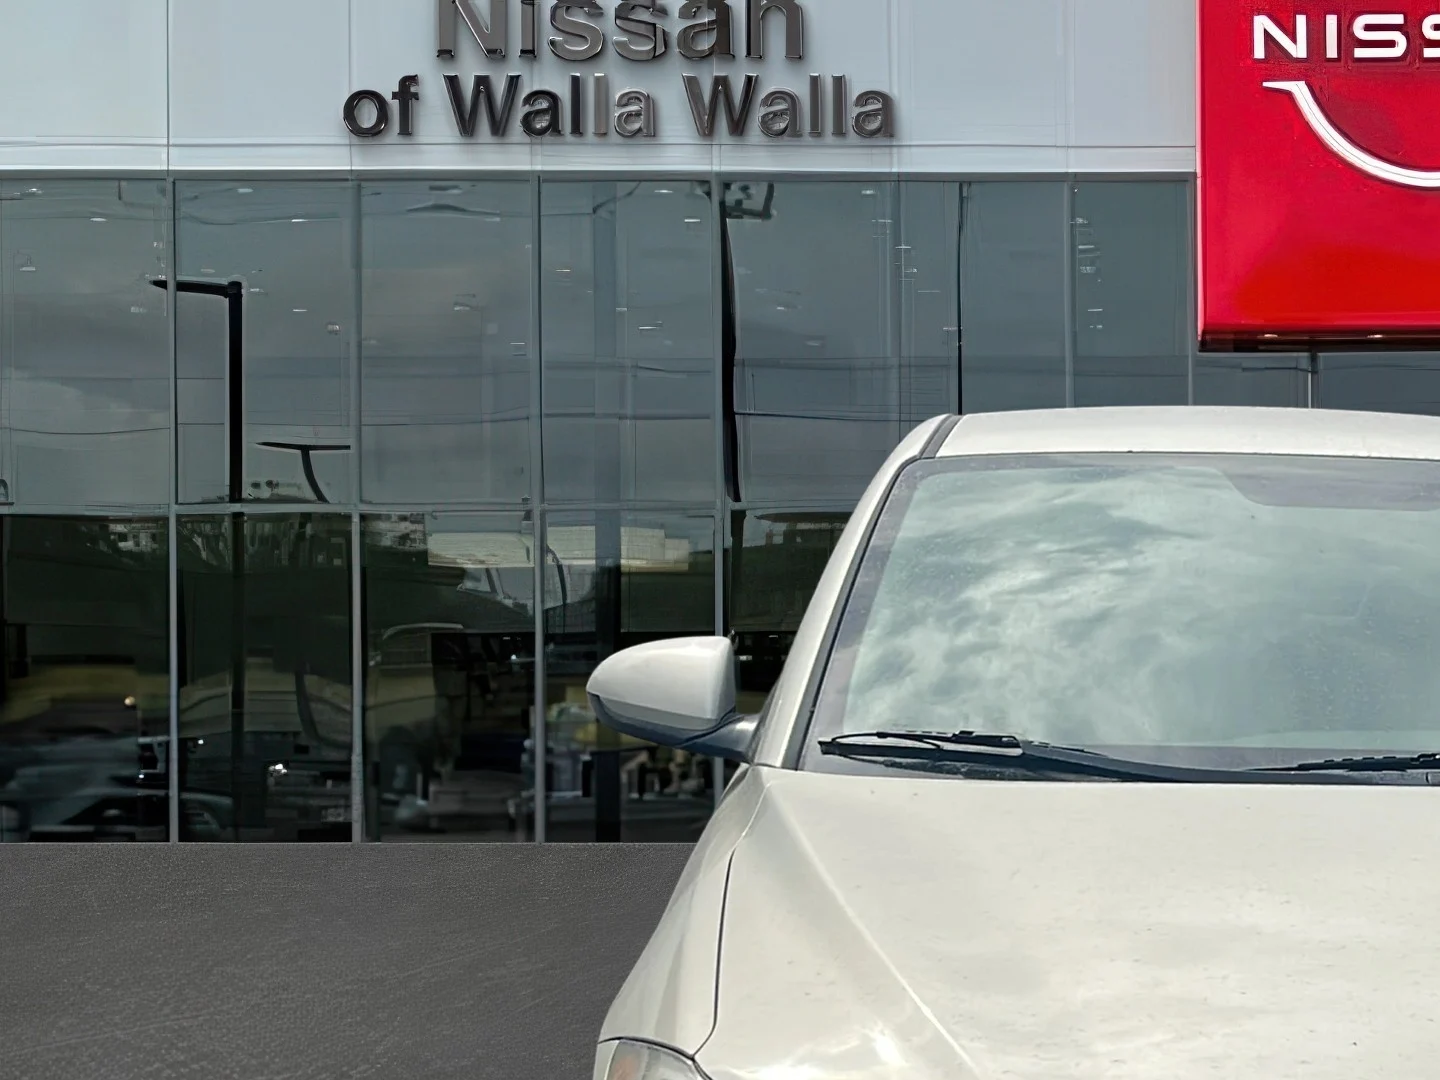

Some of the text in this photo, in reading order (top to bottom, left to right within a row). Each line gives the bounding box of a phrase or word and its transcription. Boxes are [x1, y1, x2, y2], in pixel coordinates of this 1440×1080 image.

[435, 0, 806, 61] Nissan
[342, 73, 895, 138] of Walla Walla
